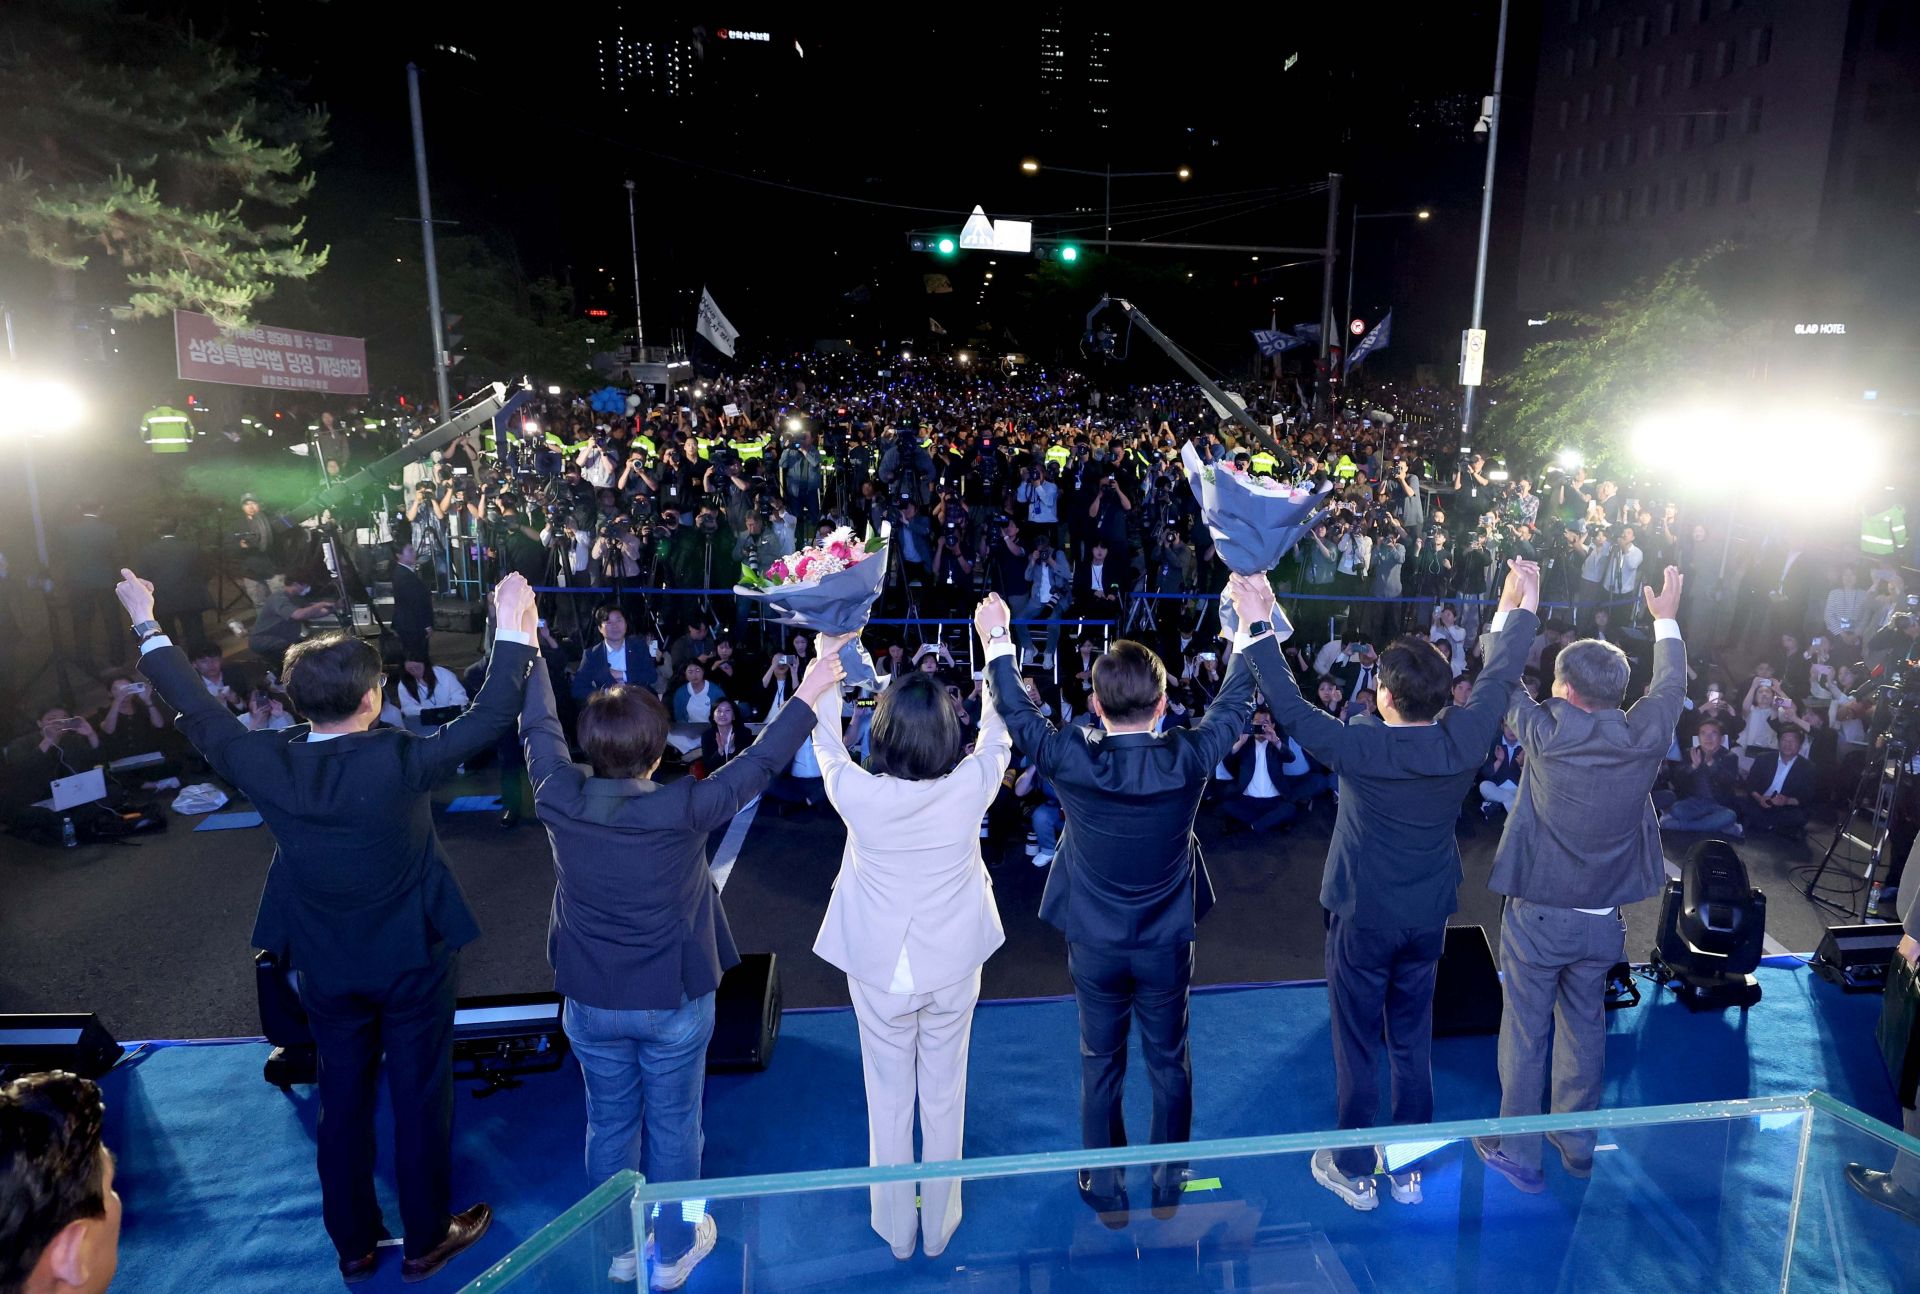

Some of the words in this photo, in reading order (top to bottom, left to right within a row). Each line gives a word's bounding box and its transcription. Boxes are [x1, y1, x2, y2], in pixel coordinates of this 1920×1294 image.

[1794, 323, 1818, 334] GLAD
[1820, 323, 1846, 334] HOTEL
[304, 335, 313, 349] 수
[188, 338, 285, 372] 삼청특별악법
[286, 351, 315, 375] 당장
[316, 355, 362, 378] 개정하라
